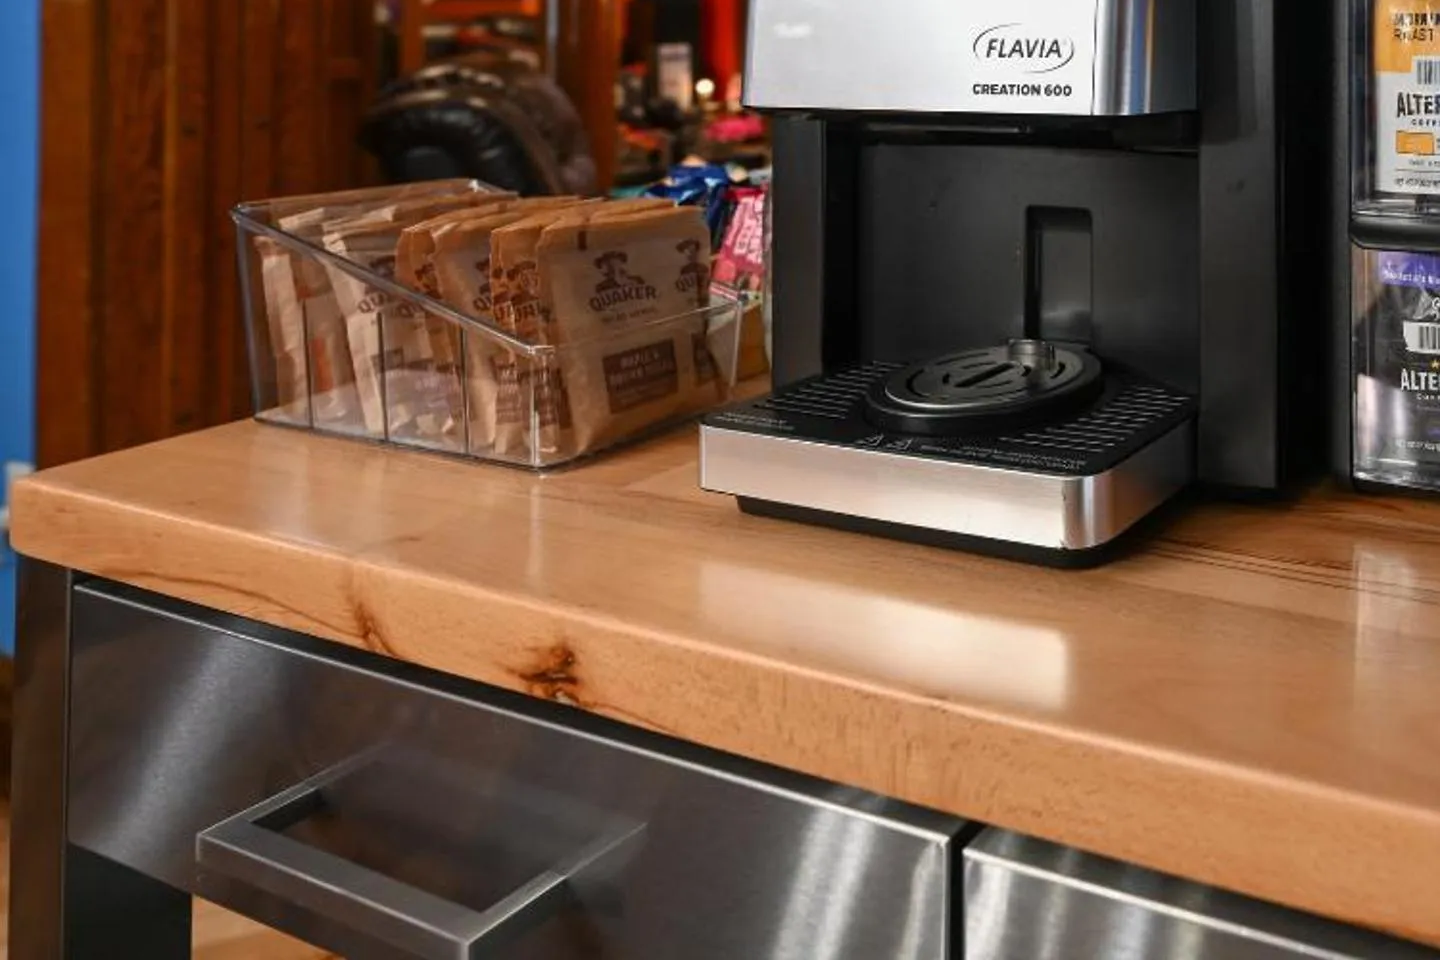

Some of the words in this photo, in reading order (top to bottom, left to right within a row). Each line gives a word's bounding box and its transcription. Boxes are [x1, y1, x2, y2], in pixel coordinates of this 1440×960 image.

[985, 38, 1063, 59] FLAVIA
[972, 83, 1042, 97] CREATION
[1044, 83, 1073, 97] 600
[589, 285, 658, 312] QUAKER
